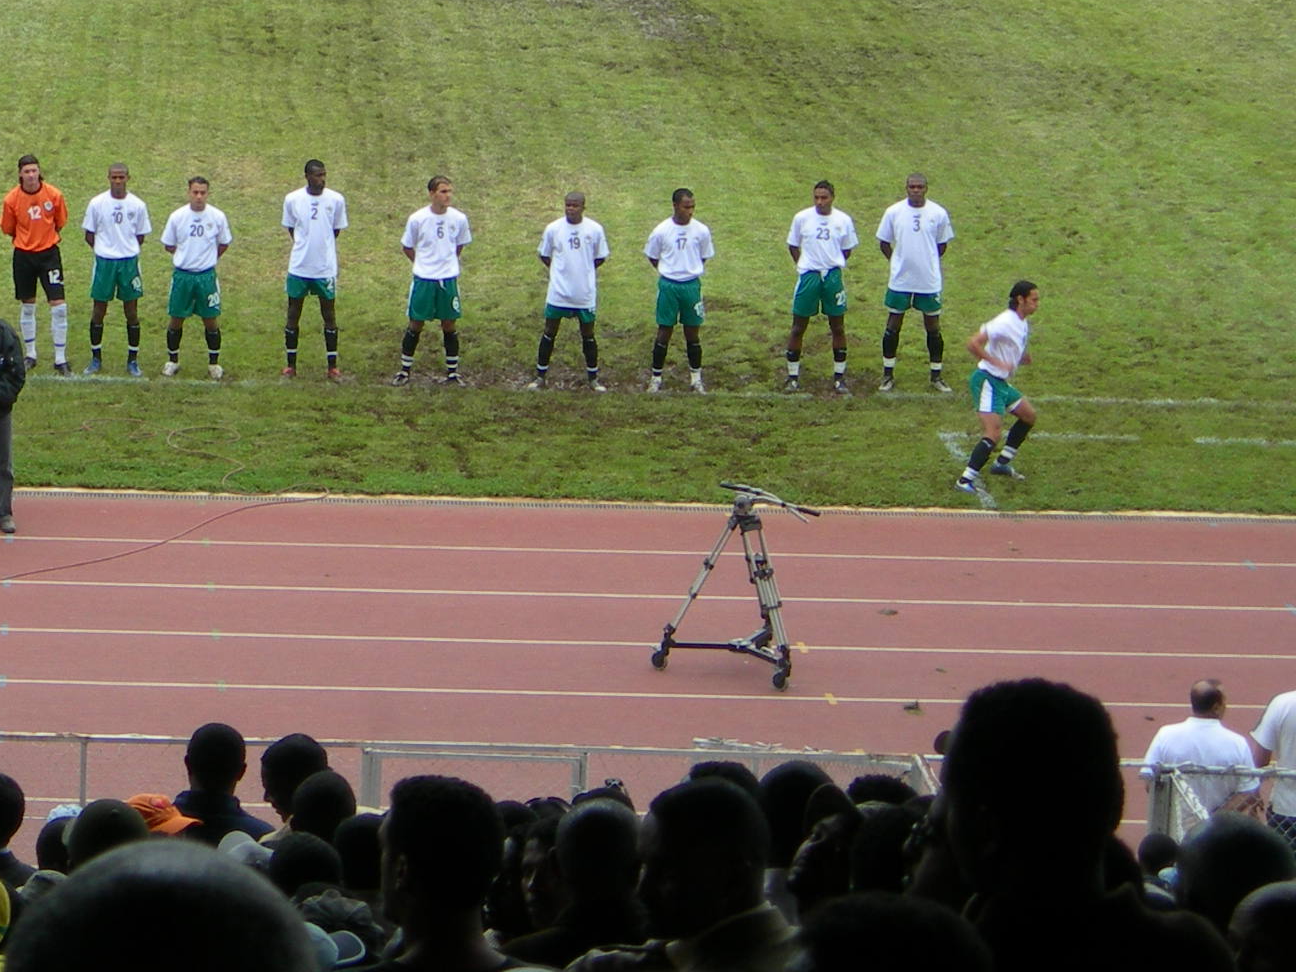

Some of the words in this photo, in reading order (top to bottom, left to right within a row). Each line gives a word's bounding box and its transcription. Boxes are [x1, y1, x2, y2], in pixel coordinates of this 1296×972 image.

[27, 205, 42, 220] 12
[111, 211, 122, 224] 10
[310, 207, 318, 220] 2
[190, 224, 204, 237] 20
[436, 226, 444, 239] 6
[912, 219, 920, 232] 3
[816, 227, 830, 241] 23
[568, 236, 580, 250] 19
[675, 237, 687, 251] 17
[48, 269, 60, 285] 12
[207, 292, 220, 308] 20
